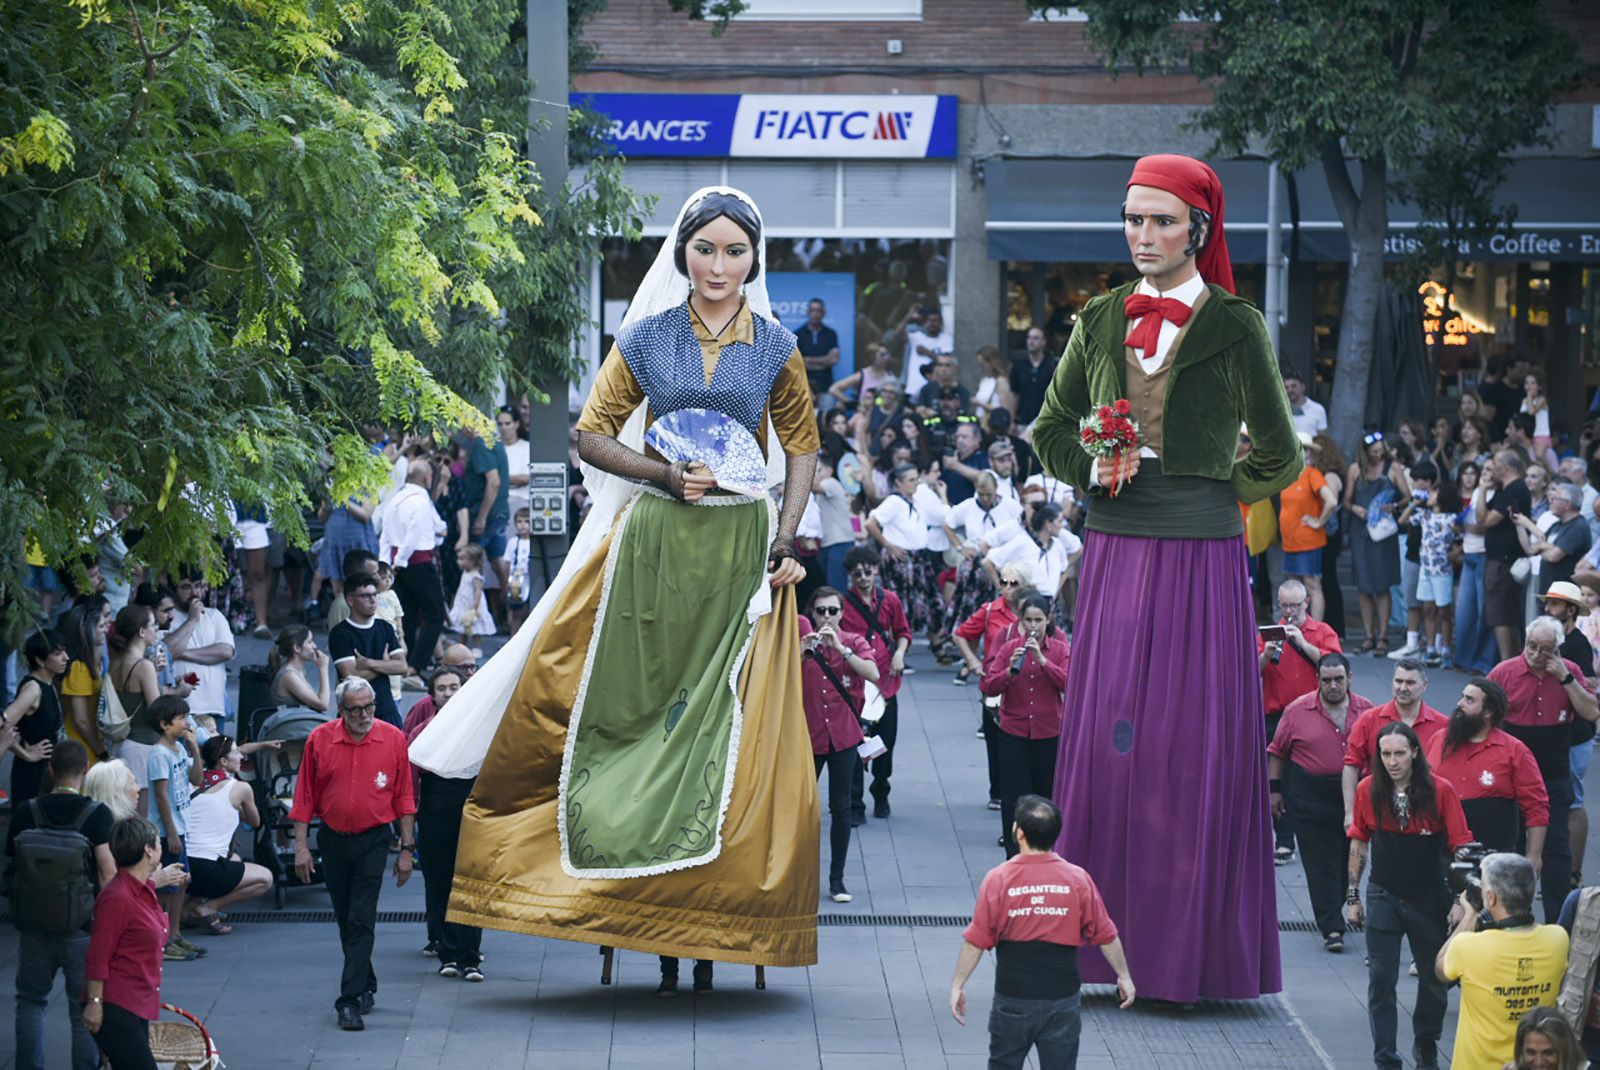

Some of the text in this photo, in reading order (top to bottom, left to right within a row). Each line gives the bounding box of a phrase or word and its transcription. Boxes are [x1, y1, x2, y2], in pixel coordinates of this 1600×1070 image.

[602, 119, 711, 141] RANCES
[1490, 232, 1561, 254] Coffee
[1008, 885, 1070, 896] GEGANTERS
[1031, 896, 1044, 904] DE
[1033, 907, 1068, 916] CUGAT
